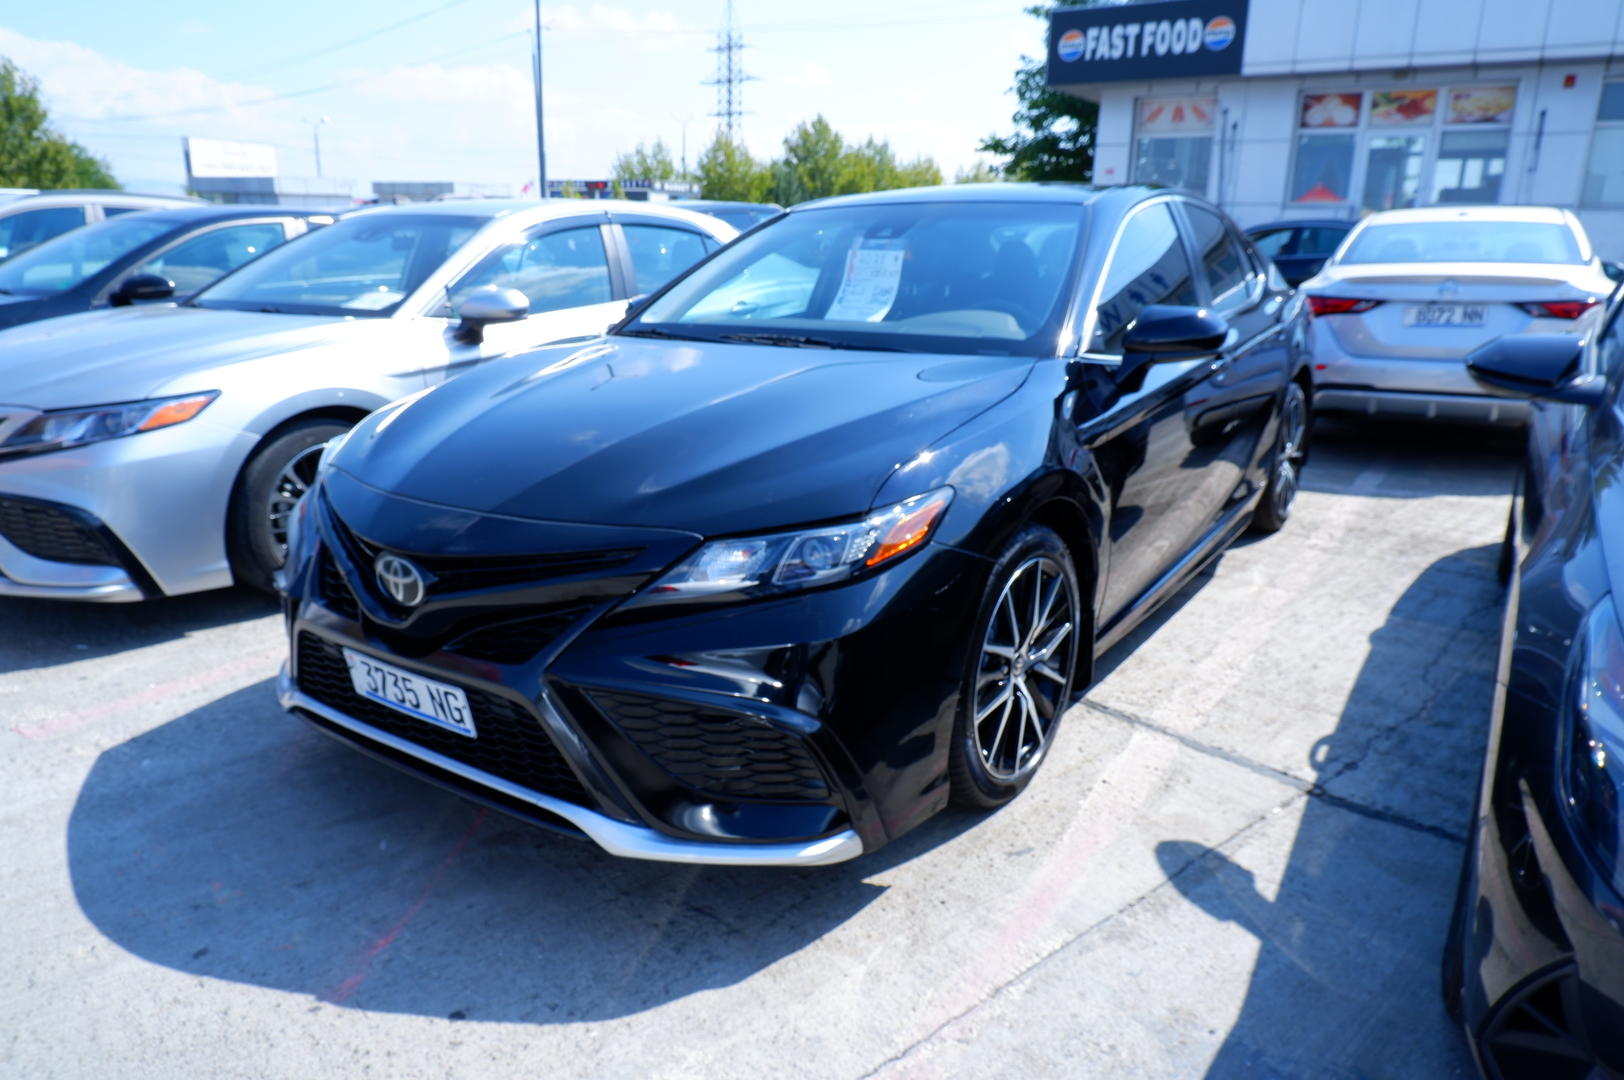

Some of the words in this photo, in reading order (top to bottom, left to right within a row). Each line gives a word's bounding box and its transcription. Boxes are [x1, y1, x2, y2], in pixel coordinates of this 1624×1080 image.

[1084, 23, 1141, 61] FAST
[1140, 17, 1204, 57] FOOD
[360, 660, 421, 710] 3735
[426, 684, 466, 725] NG
